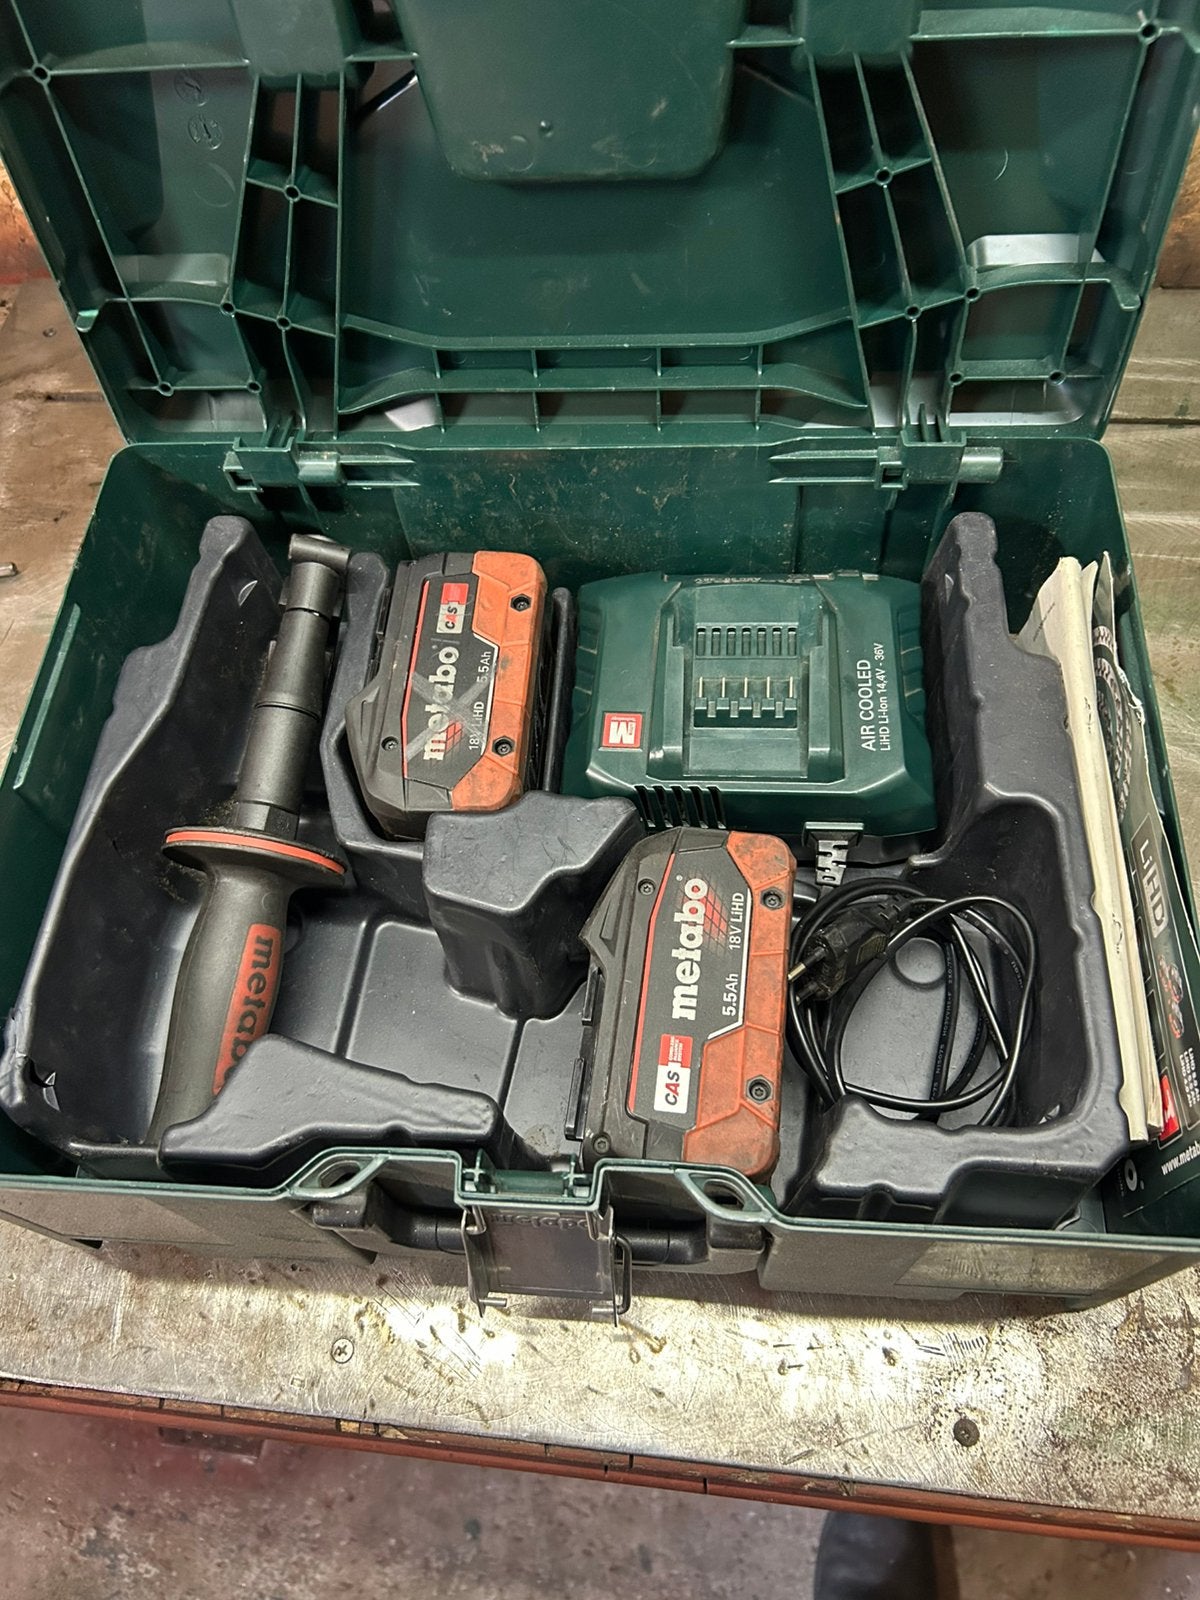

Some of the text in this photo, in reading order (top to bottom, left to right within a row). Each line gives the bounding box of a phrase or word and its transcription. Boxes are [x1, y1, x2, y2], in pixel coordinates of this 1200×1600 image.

[445, 605, 458, 629] CAS
[477, 651, 492, 683] 5.5Ah
[873, 643, 885, 661] 36V
[875, 668, 889, 694] 14,4V
[423, 646, 460, 760] metabo
[856, 660, 876, 751] AIR COOLED
[877, 696, 889, 724] Li-Ion
[879, 726, 891, 751] LiHD
[1140, 839, 1165, 928] LiHD
[672, 878, 708, 1020] metabo
[722, 892, 745, 1016] 5.5Ah 18V LiHD
[224, 935, 275, 1083] metab
[665, 1070, 681, 1106] CAS
